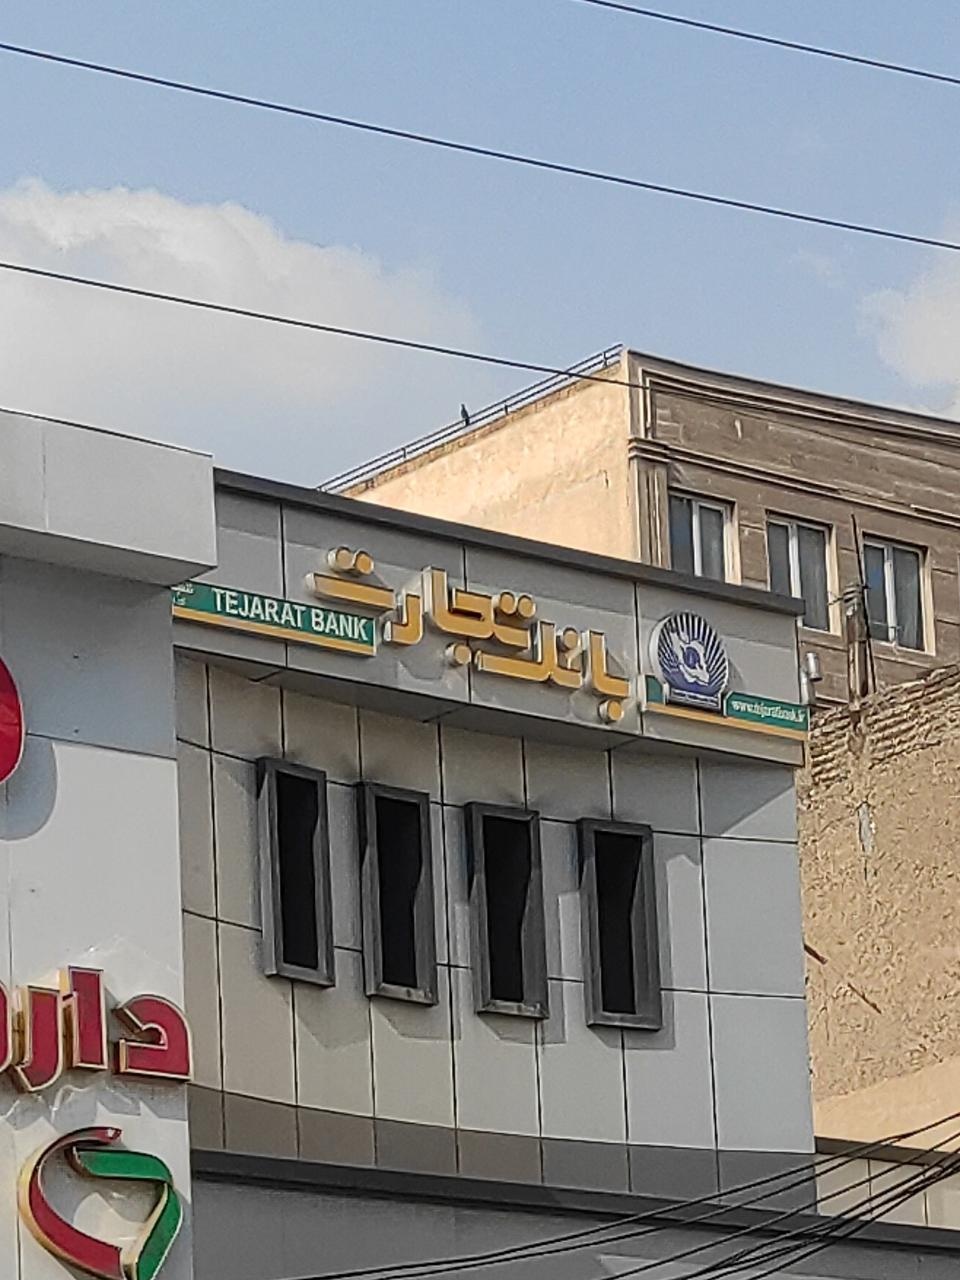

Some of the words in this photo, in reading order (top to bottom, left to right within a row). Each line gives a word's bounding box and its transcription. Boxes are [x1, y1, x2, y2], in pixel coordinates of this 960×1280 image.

[211, 587, 306, 628] TEJARAT
[311, 610, 369, 641] BANK
[305, 546, 537, 665] تجارت
[476, 620, 631, 722] بانک
